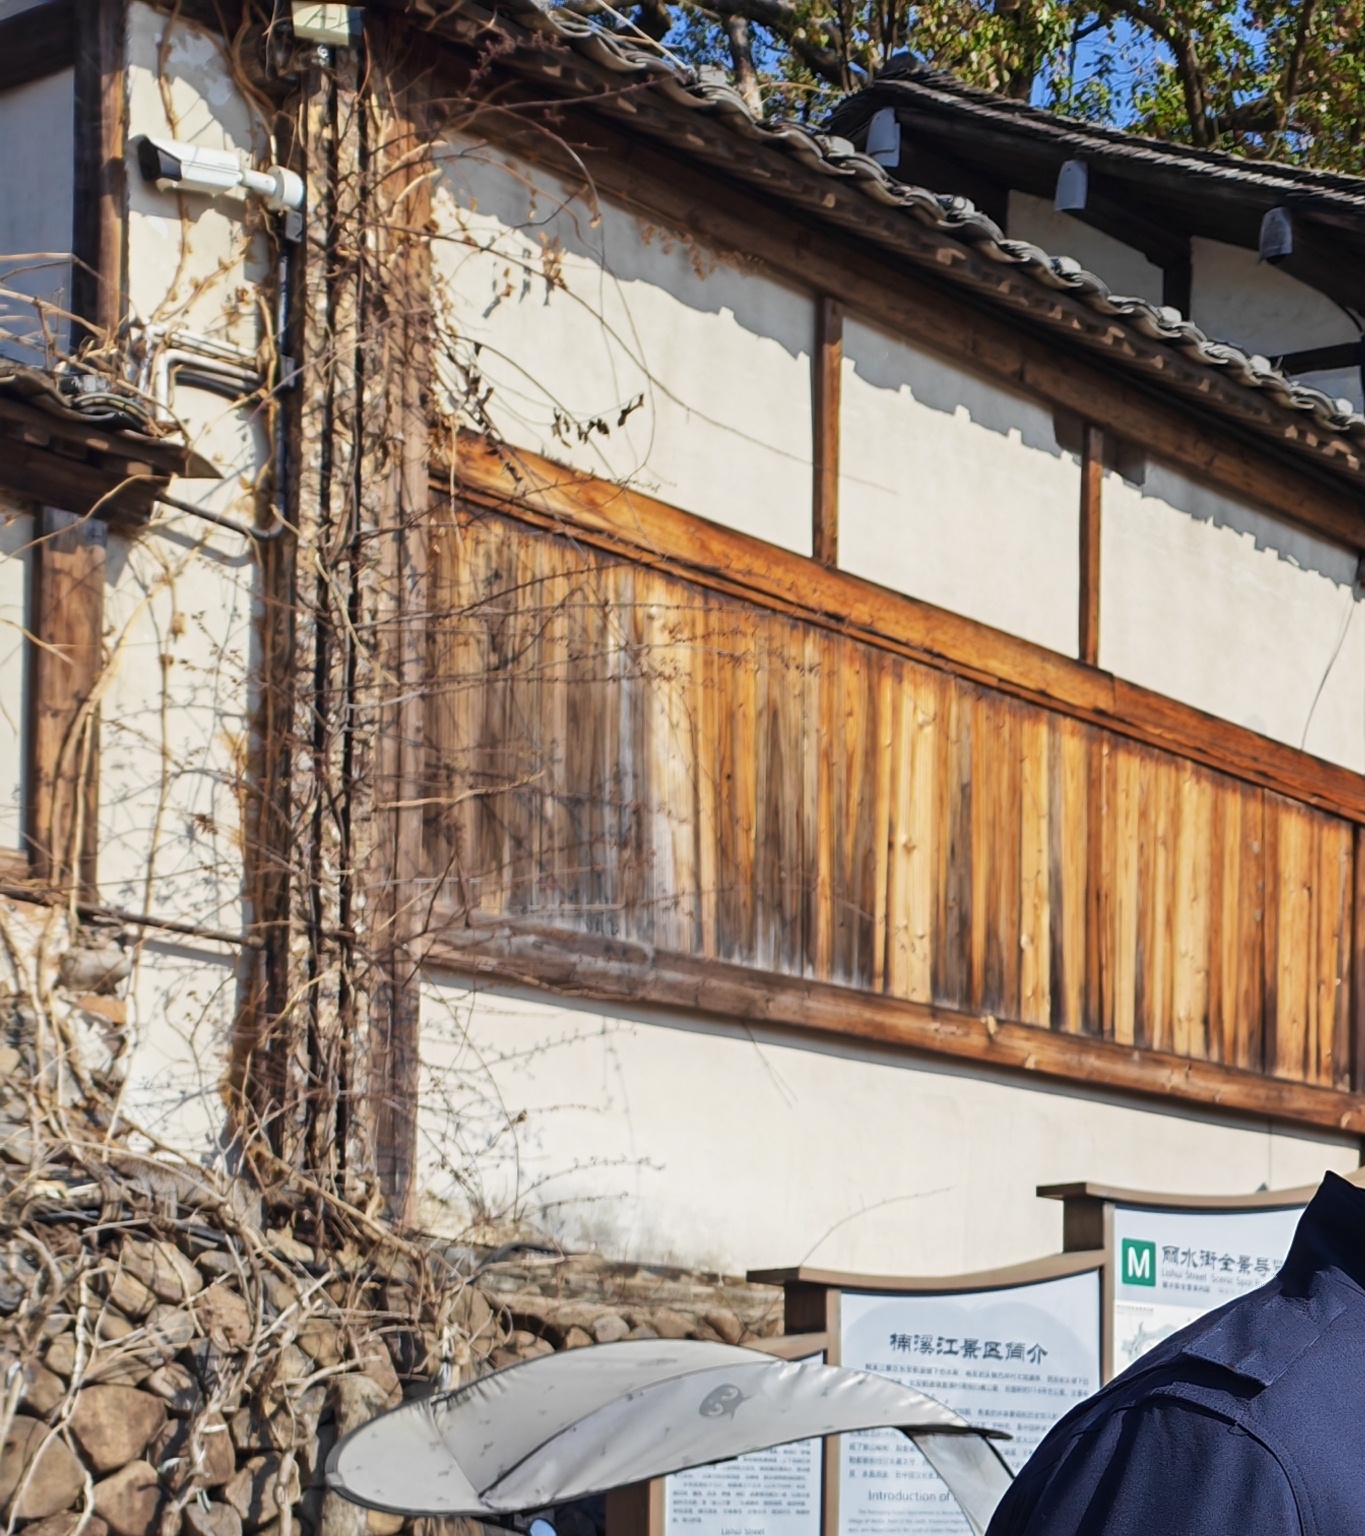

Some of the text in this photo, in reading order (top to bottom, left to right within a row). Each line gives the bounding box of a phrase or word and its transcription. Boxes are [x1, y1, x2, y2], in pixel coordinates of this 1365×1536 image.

[1127, 1246, 1151, 1280] M
[1185, 1270, 1208, 1282] Street
[889, 1331, 1049, 1365] 楠溪江景区简介
[868, 1489, 951, 1502] Introduction of
